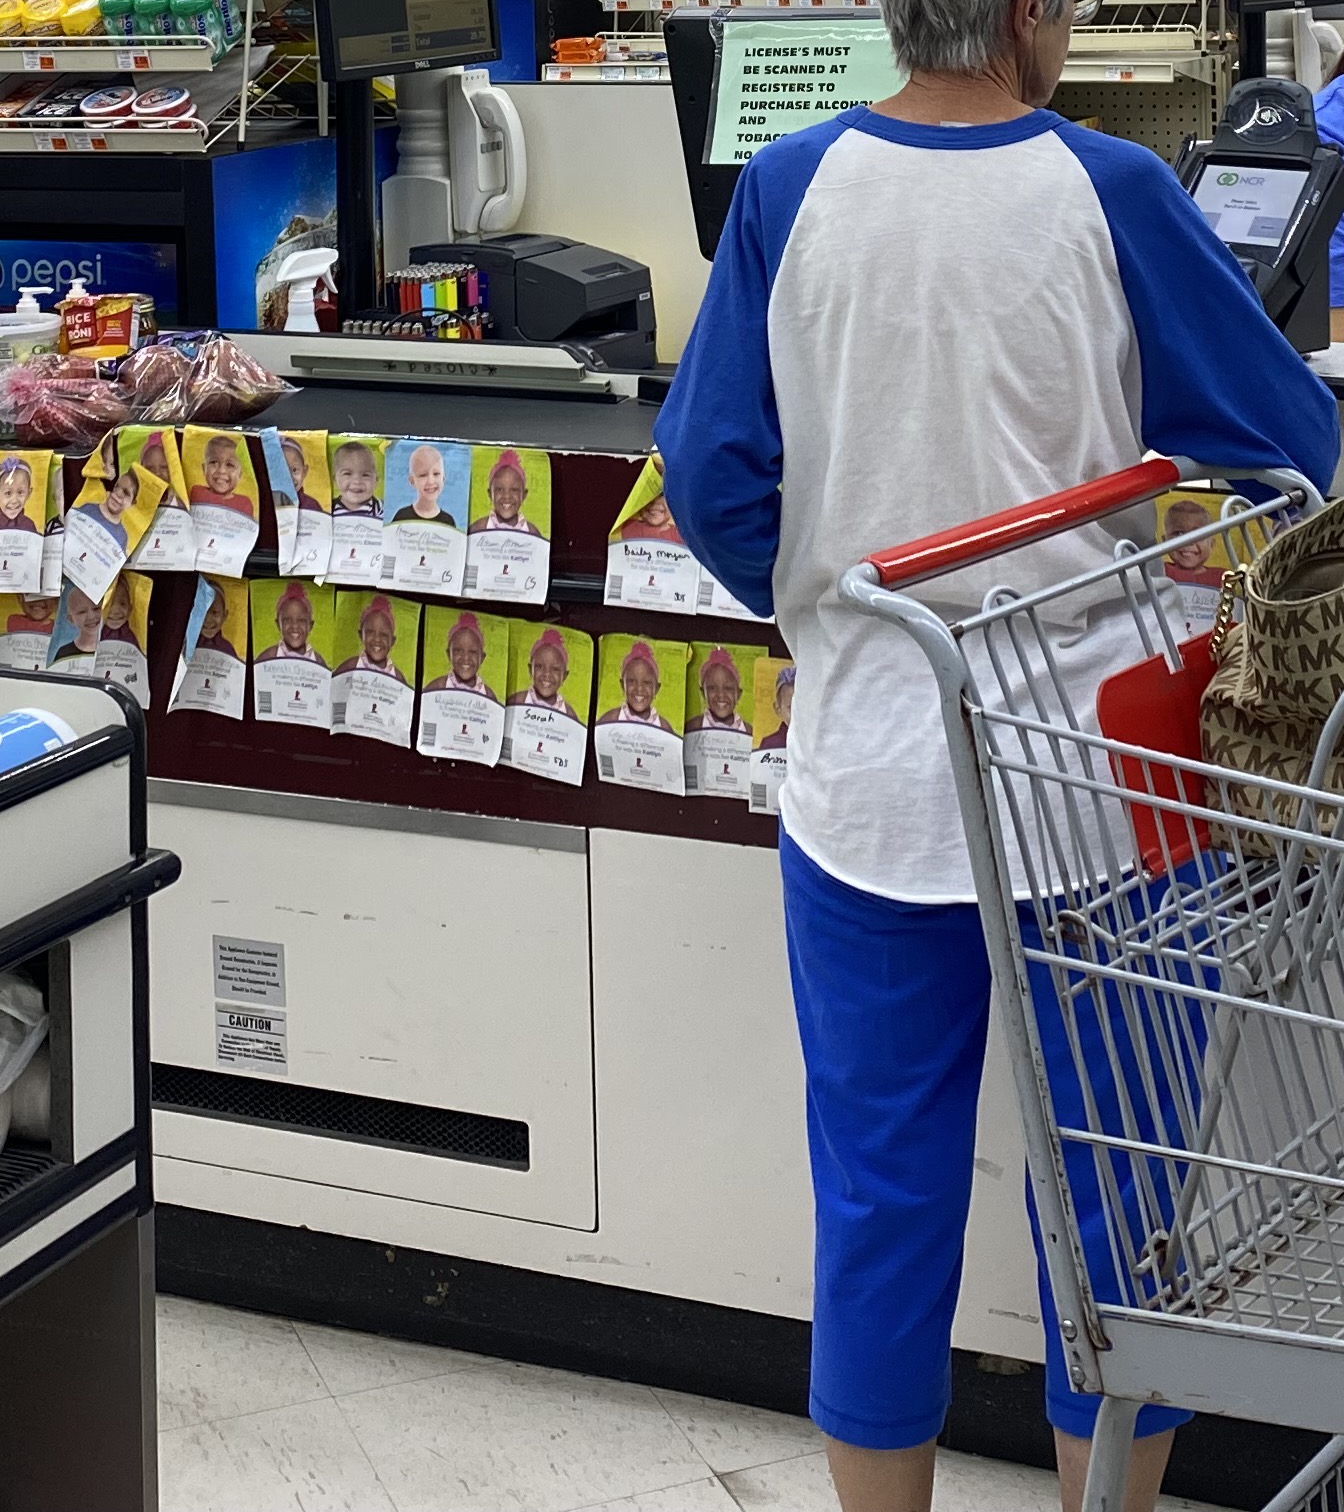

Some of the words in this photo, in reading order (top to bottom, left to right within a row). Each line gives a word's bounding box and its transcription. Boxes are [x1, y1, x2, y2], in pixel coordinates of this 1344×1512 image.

[744, 47, 810, 57] LICENSE'S
[813, 46, 851, 56] MUST
[415, 60, 430, 69] DELL
[743, 65, 760, 75] BE
[764, 64, 825, 75] SCANNED
[829, 64, 847, 74] AT
[741, 83, 814, 93] REGISTERS
[818, 82, 836, 92] TO
[37, 105, 70, 116] ICE
[740, 101, 811, 110] PURCHASE
[738, 116, 766, 125] AND
[734, 150, 753, 160] NO
[1240, 176, 1266, 187] NCR
[12, 254, 103, 291] pepsi
[65, 312, 92, 326] RICE
[67, 327, 93, 340] RONI
[523, 708, 555, 723] Sarah
[229, 1015, 271, 1031] CAUTION
